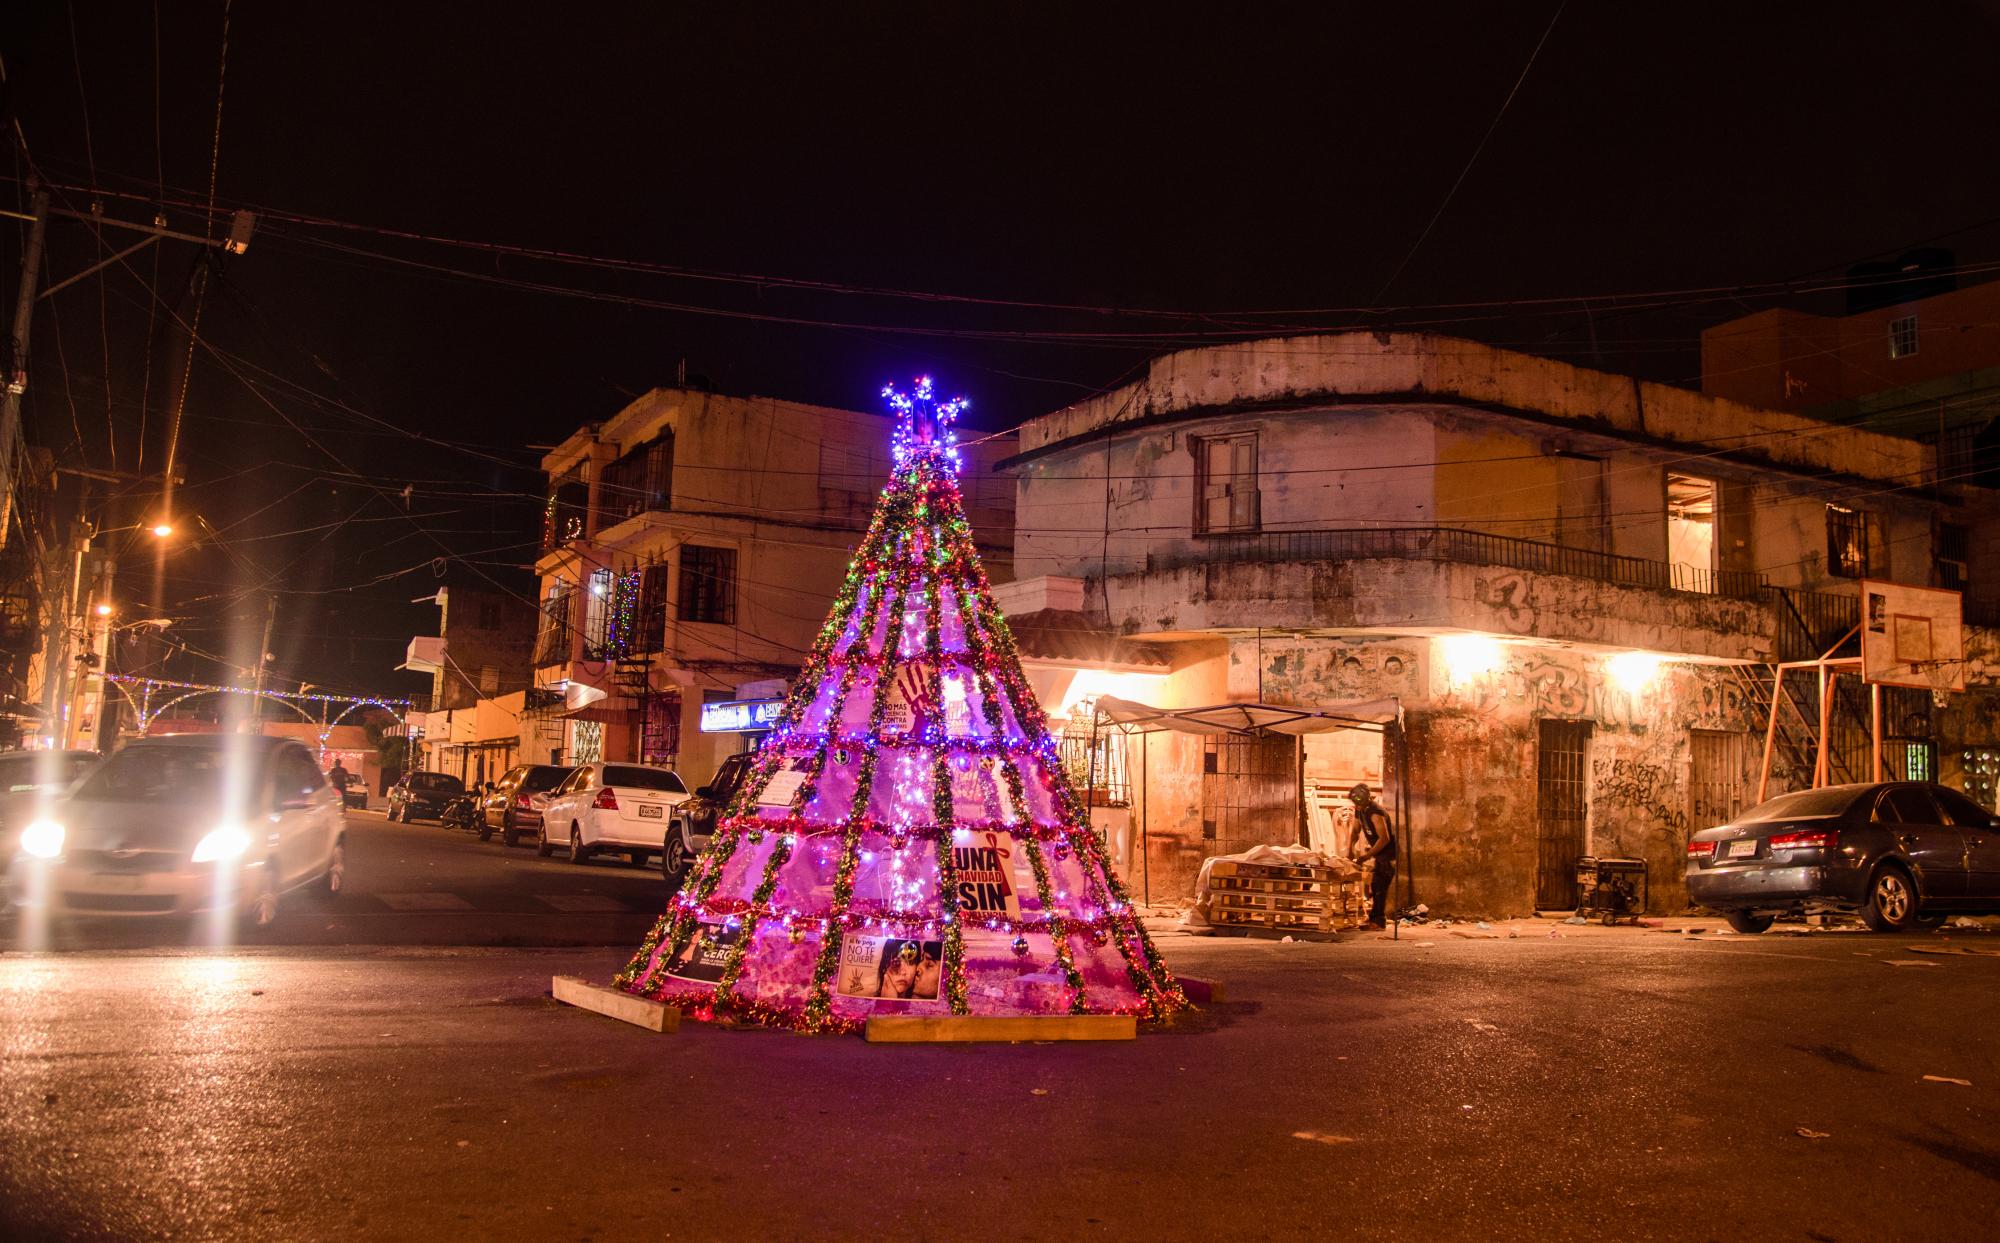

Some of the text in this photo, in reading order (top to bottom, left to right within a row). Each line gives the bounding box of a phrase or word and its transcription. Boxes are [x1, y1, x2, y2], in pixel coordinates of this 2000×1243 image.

[955, 847, 999, 871] UNA
[957, 871, 1002, 883] NAVIDAD
[959, 882, 1007, 911] SIN
[847, 945, 875, 955] NO TE
[846, 954, 874, 964] QUIERE
